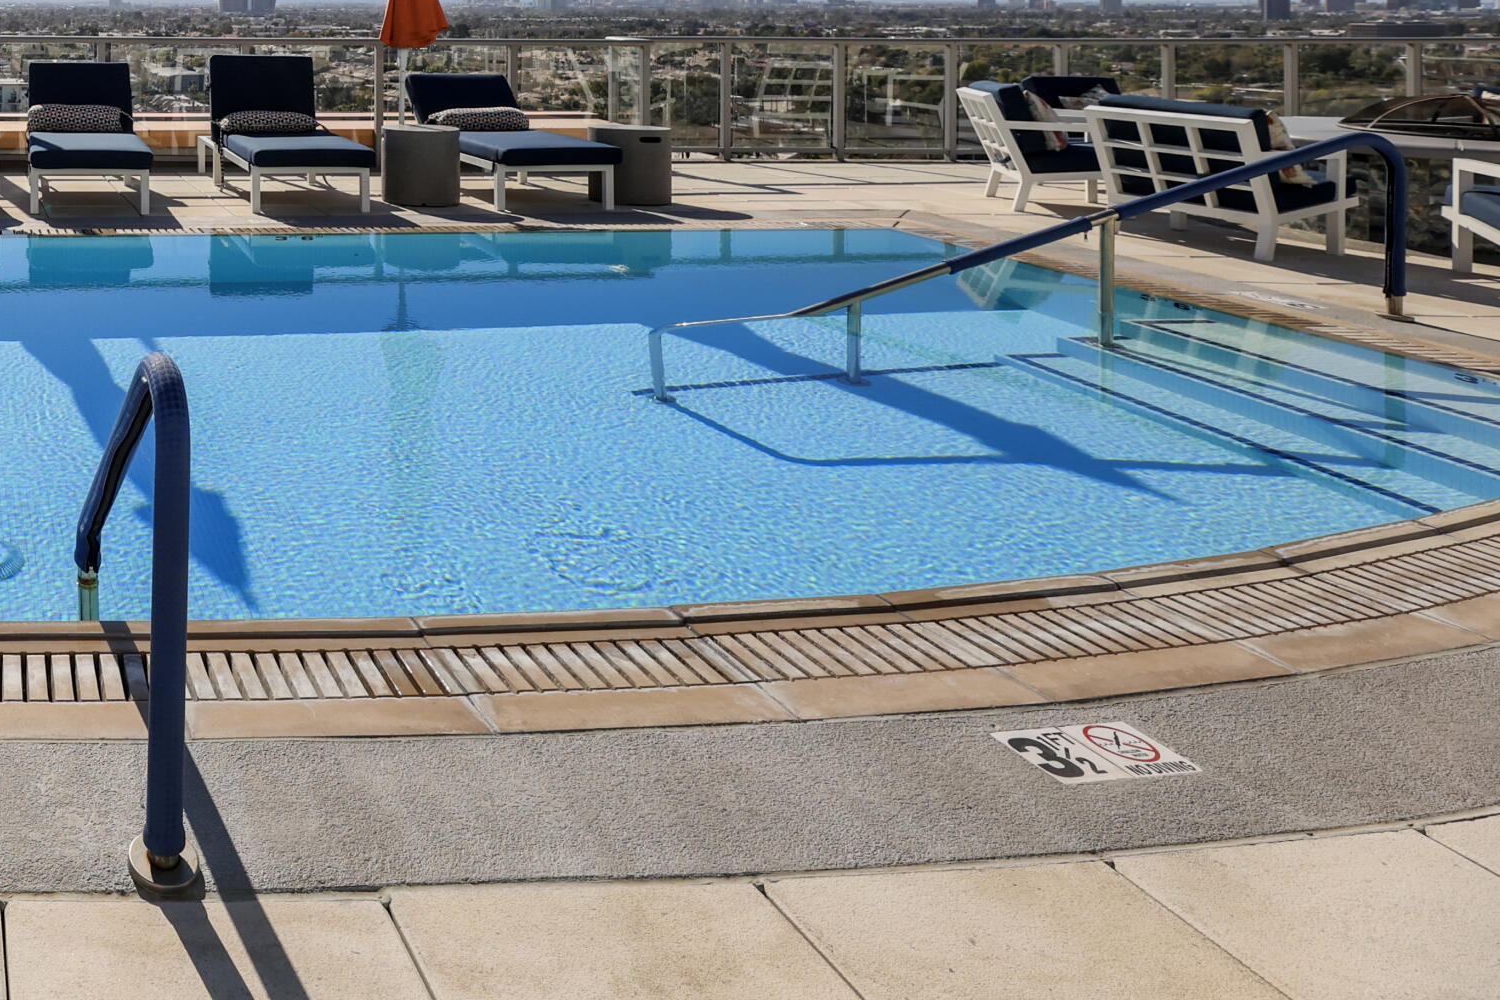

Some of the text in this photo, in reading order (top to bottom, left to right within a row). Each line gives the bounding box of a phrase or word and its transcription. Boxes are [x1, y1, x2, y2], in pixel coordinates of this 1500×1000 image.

[1041, 732, 1075, 746] FT
[1125, 760, 1197, 775] NO DIVING
